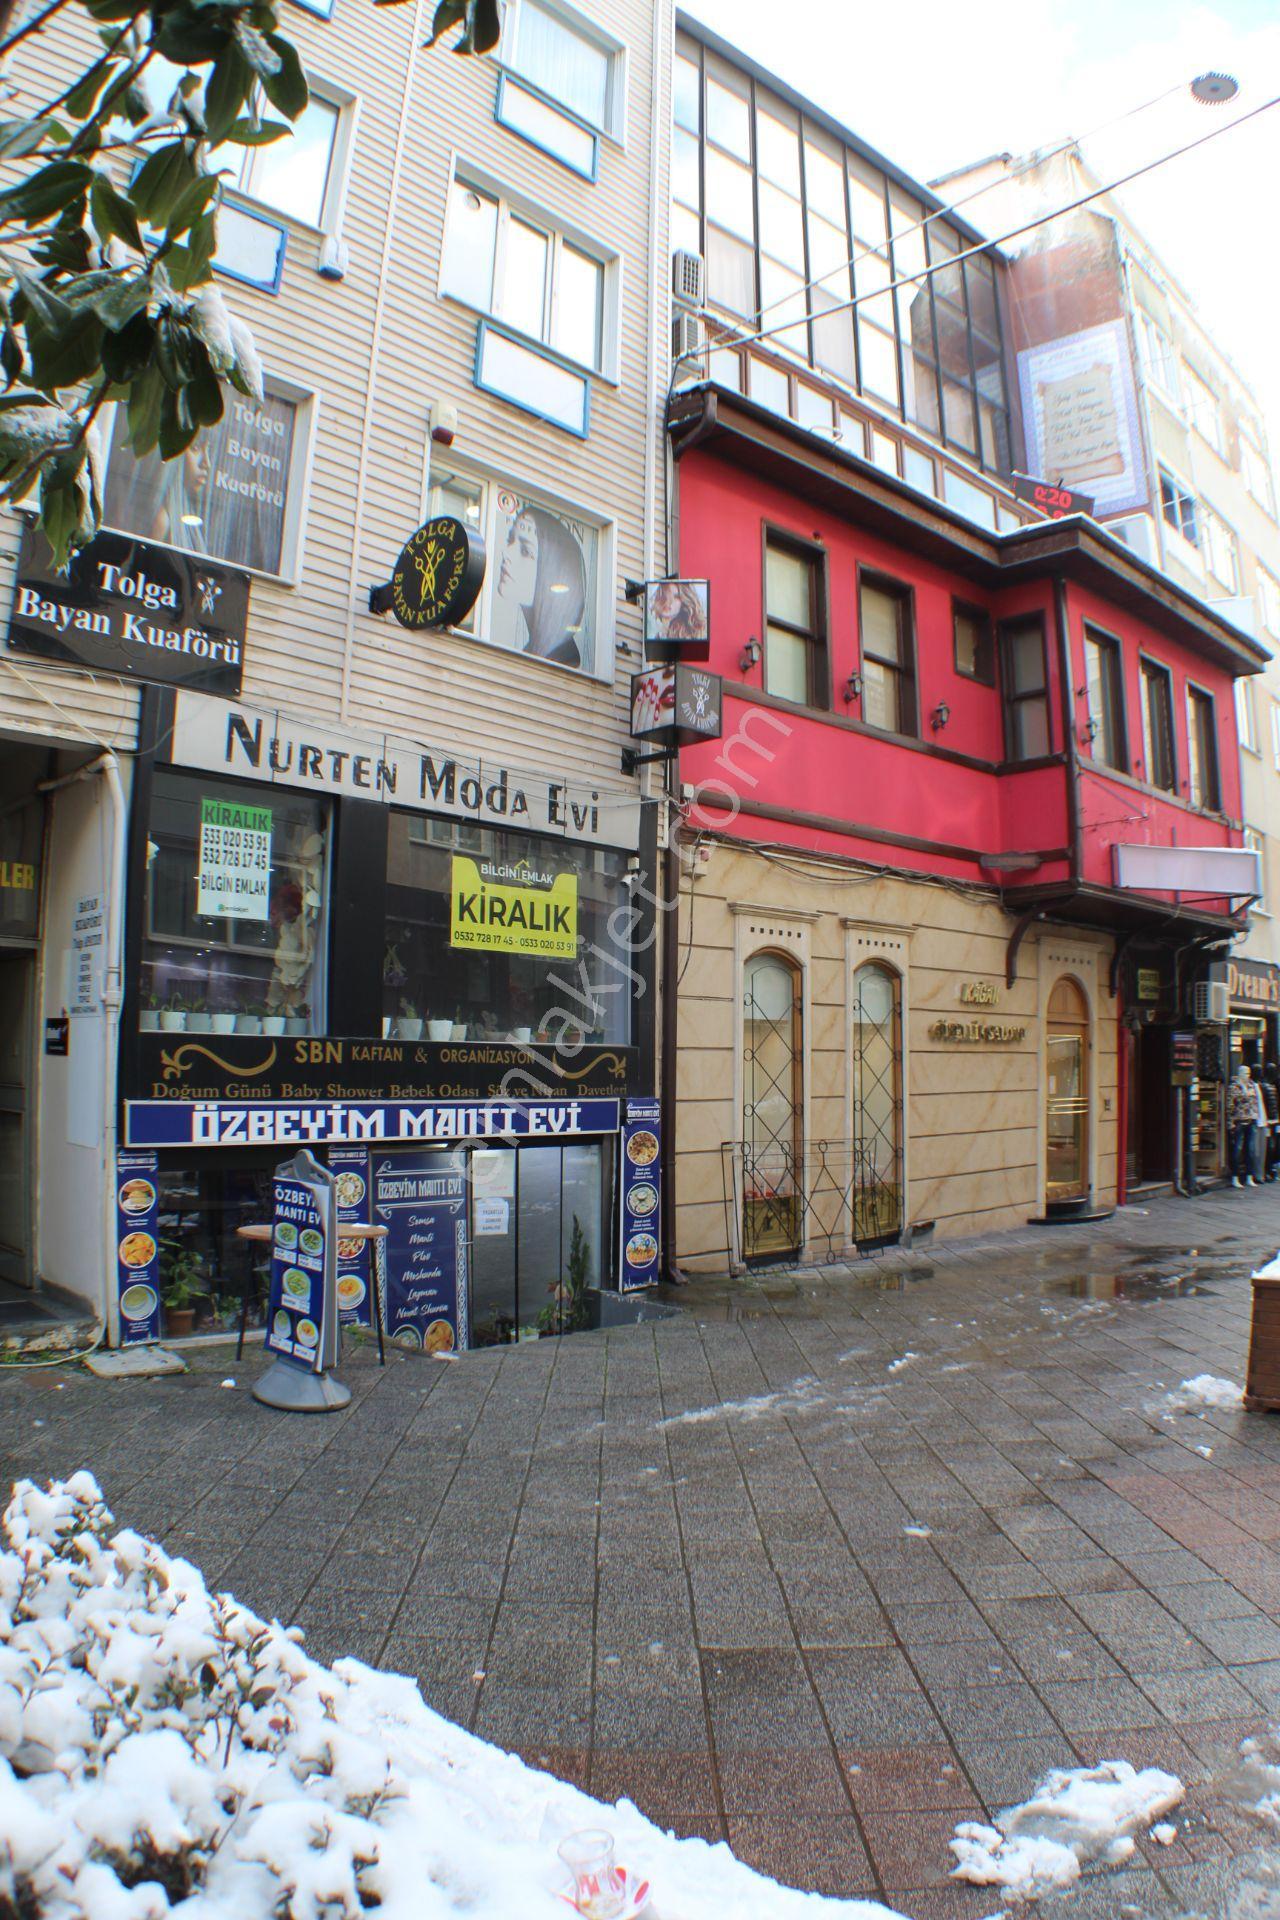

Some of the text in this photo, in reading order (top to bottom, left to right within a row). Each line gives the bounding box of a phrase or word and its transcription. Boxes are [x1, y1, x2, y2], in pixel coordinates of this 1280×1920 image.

[232, 401, 286, 437] Tolga
[227, 438, 282, 472] Bayan
[215, 469, 284, 508] Kuaförü
[403, 518, 457, 556] TOLGA
[98, 562, 177, 610] Tolga
[16, 586, 240, 665] Bayan Kuaförü
[204, 803, 269, 831] KİRALIK
[204, 827, 267, 852] 533 020 53 91
[203, 847, 267, 871] 532 728 17 45
[201, 871, 267, 897] BİLGİN EMLAK
[481, 862, 553, 884] BİLGİN EMLAK
[458, 886, 571, 934] KİRALIK
[454, 930, 475, 942] 0532
[477, 932, 492, 944] 728
[493, 934, 501, 945] 17
[503, 936, 513, 945] 45
[520, 938, 538, 948] 0533
[540, 940, 555, 950] 020
[556, 941, 565, 951] 53
[567, 942, 574, 951] 91
[294, 1040, 536, 1065] SBN KAFTAN & ORGANİZASYON
[152, 1082, 219, 1100] Doğum
[225, 1083, 272, 1098] Günü
[281, 1083, 322, 1101] Baby
[326, 1083, 384, 1098] Shower
[390, 1084, 435, 1098] Bebek
[439, 1084, 480, 1097] Odası
[514, 1086, 528, 1096] ve
[577, 1083, 627, 1096] Davetleri
[192, 1102, 582, 1142] ÖZBEYİM MANTI EVİ
[377, 1175, 463, 1200] ÖZBEYİM MANTI EVİ
[275, 1204, 306, 1223] MANTI
